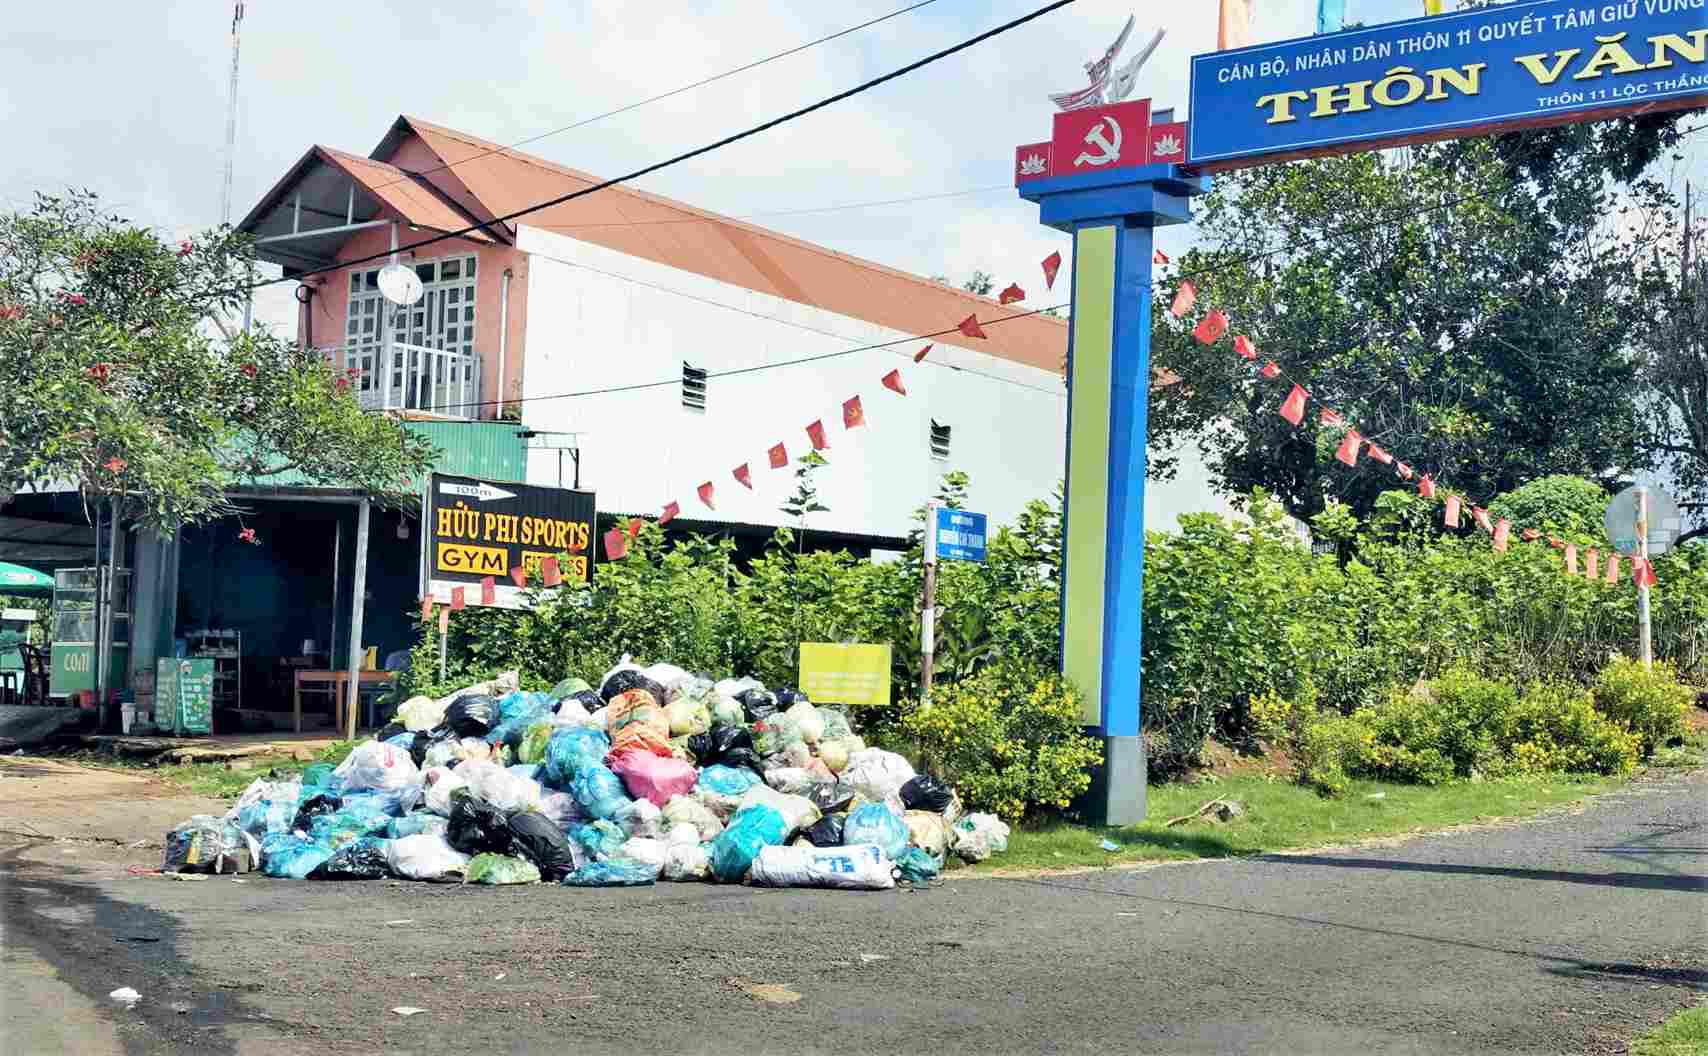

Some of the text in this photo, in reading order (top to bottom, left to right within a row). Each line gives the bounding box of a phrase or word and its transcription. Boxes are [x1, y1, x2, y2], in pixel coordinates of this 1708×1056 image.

[1295, 48, 1347, 72] NHÂN
[1352, 40, 1391, 62] DÂN
[1397, 32, 1450, 55] THÔN
[1456, 29, 1471, 46] 11
[1478, 12, 1546, 42] QUYẾT
[1553, 8, 1596, 30] TÂM
[1256, 29, 1708, 125] THÔN VĂN
[1535, 89, 1585, 108] THÔN
[1590, 89, 1606, 100] 11
[1613, 83, 1648, 99] LỘC
[455, 486, 492, 497] 100m
[483, 512, 518, 544] PHI
[521, 517, 590, 551] SPORTS
[442, 548, 504, 571] GYM
